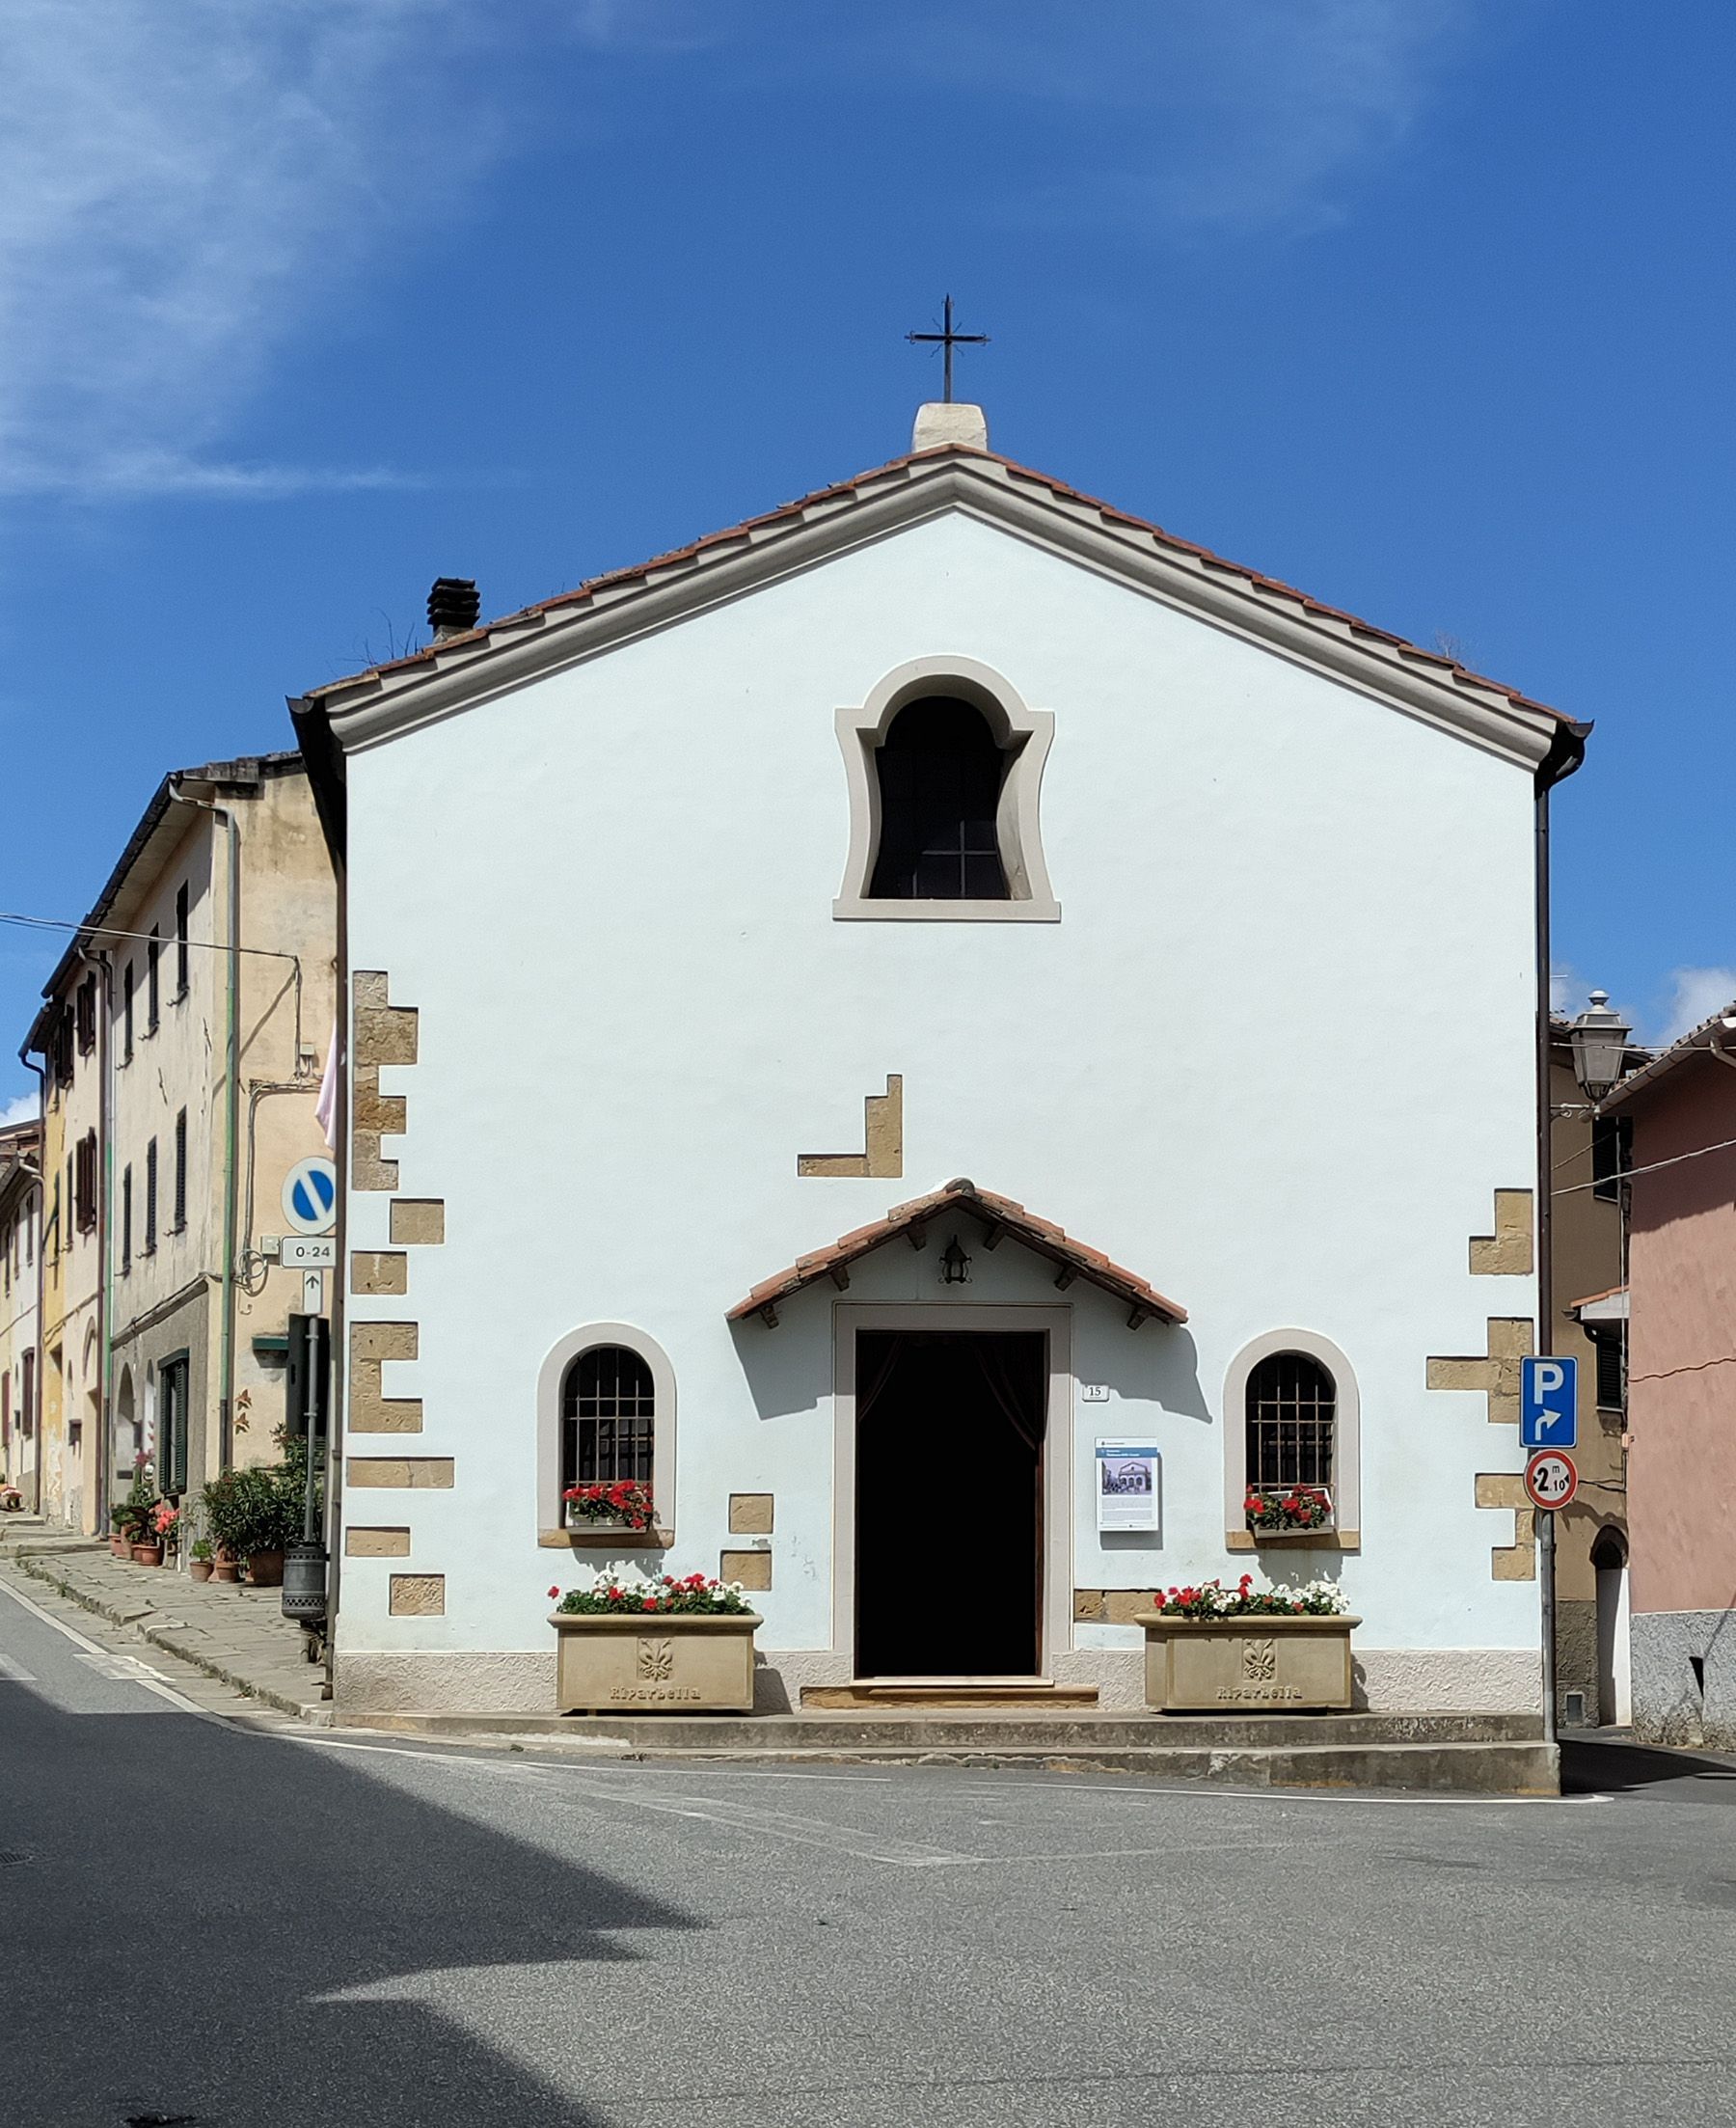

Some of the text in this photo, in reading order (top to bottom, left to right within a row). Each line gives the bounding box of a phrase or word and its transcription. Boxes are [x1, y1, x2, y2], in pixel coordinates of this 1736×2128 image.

[295, 1246, 330, 1258] 0-24
[1533, 1362, 1564, 1405] P
[1090, 1386, 1101, 1397] 15
[1552, 1465, 1560, 1474] m
[610, 1685, 702, 1702] Riparbella
[1215, 1685, 1304, 1701] Riparbella
